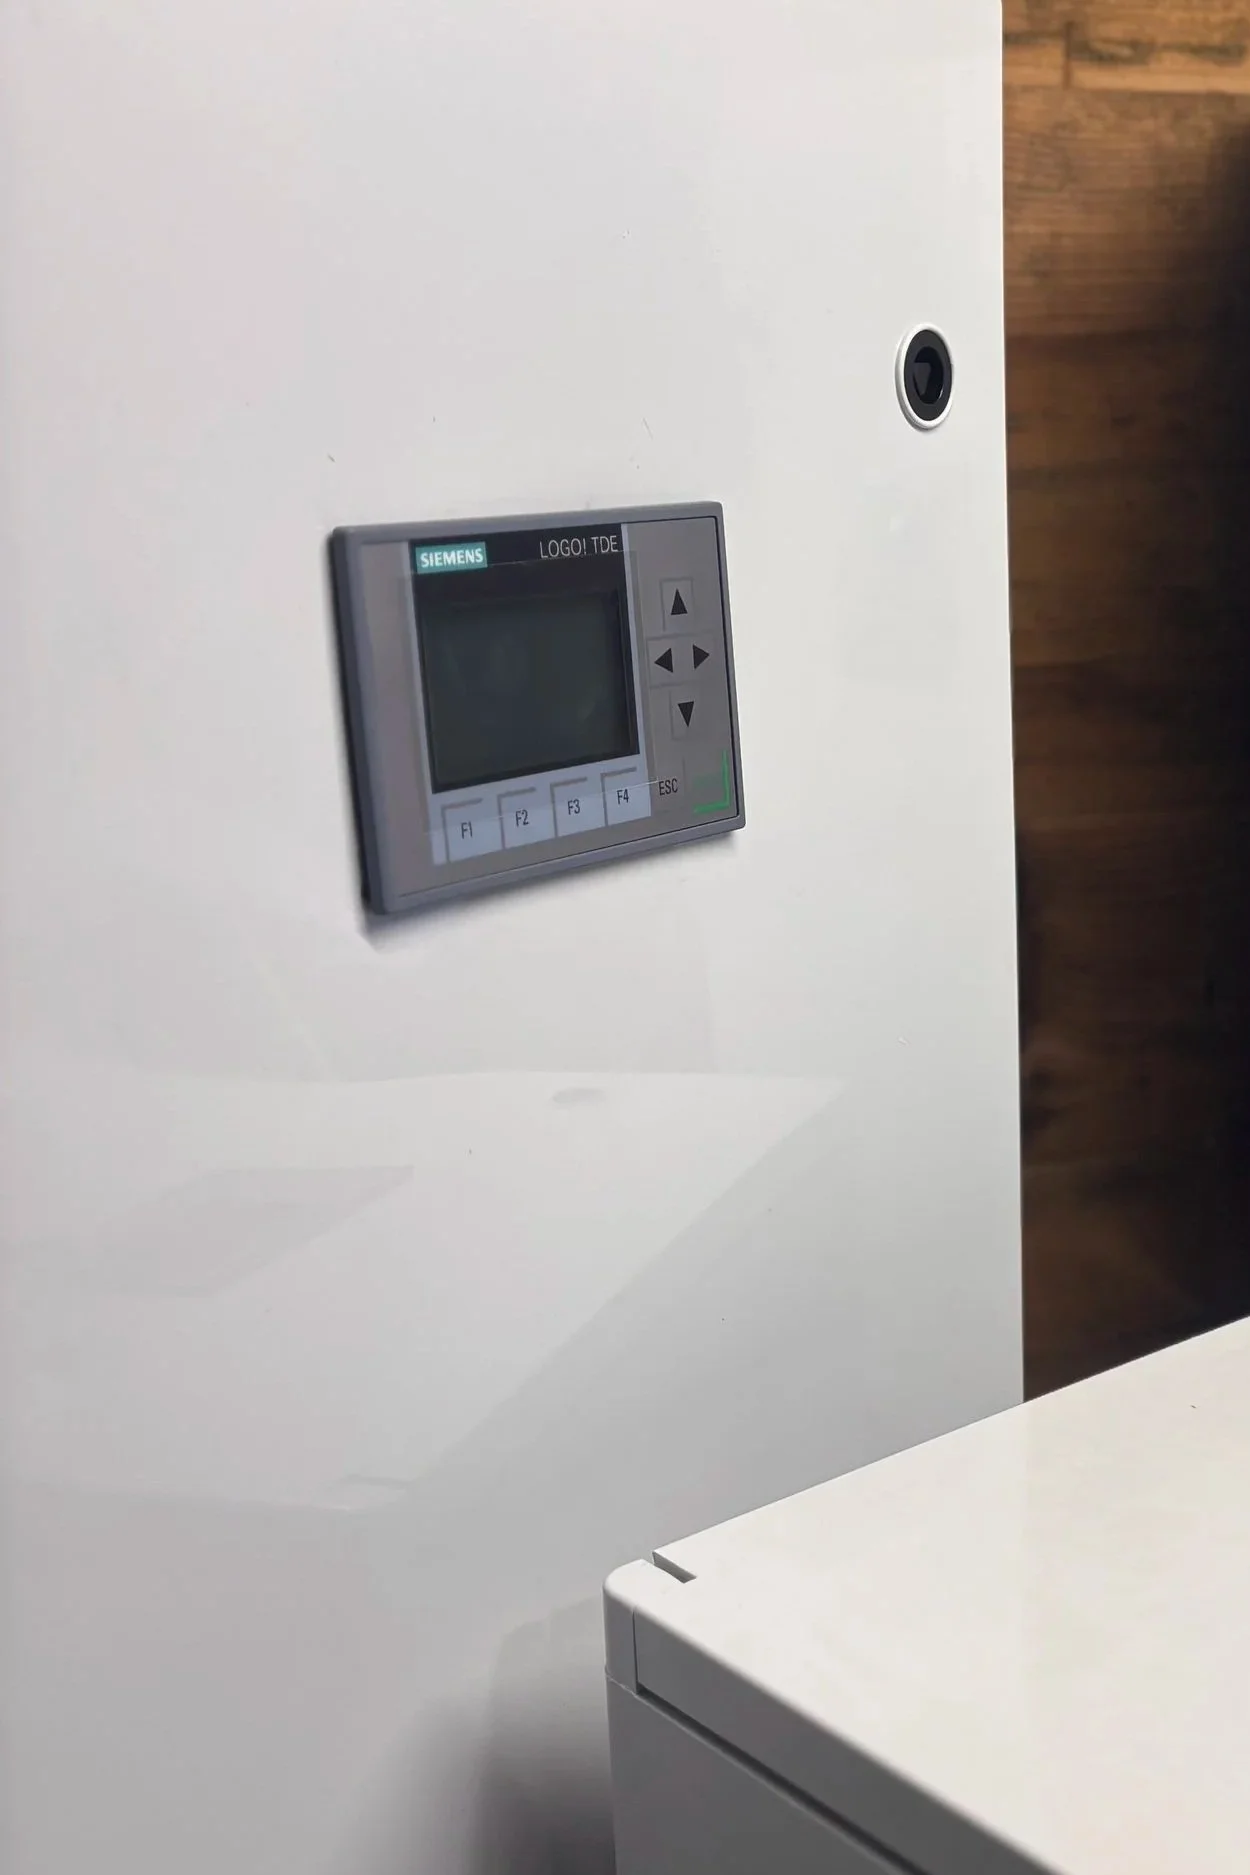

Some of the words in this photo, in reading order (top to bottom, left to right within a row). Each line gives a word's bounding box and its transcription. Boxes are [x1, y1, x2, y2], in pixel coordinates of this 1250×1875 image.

[540, 538, 587, 558] LOGO!
[591, 535, 618, 553] TDE
[420, 548, 484, 567] SIEMENS
[658, 778, 678, 796] ESC
[461, 821, 473, 839] F1
[515, 810, 528, 827] F2
[567, 799, 580, 815] F3
[617, 788, 629, 805] F4
